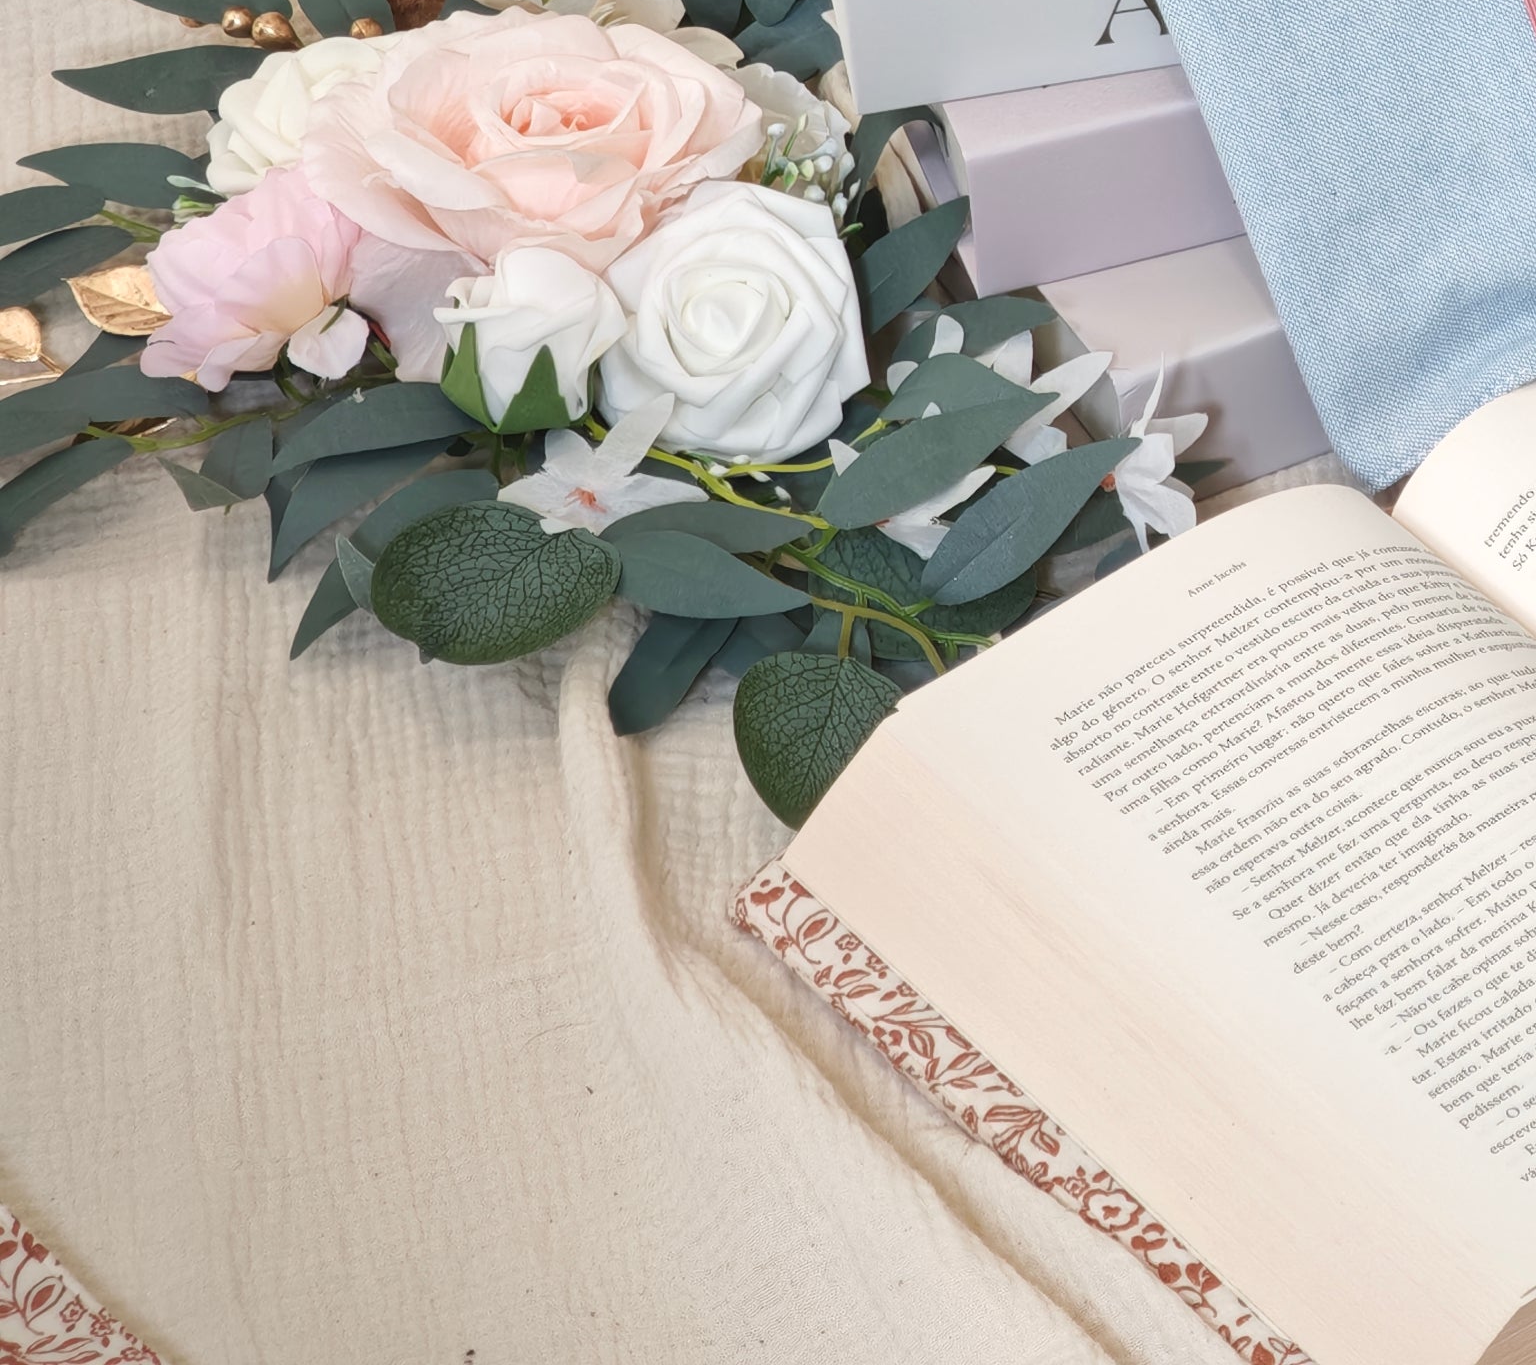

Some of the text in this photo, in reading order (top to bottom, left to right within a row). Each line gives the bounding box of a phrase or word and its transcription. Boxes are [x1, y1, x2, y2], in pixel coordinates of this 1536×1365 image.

[1187, 562, 1247, 598] Anne Jacobs
[1484, 490, 1535, 548] tremendo
[1498, 524, 1529, 559] tenha
[1512, 552, 1528, 572] Só
[1049, 731, 1079, 751] algo
[1081, 718, 1100, 732] do
[1151, 673, 1166, 686] O
[1168, 644, 1213, 678] senhor
[1213, 616, 1260, 648] Melzer
[1263, 573, 1354, 619] contemplou-a
[1353, 564, 1378, 579] por
[1379, 559, 1404, 569] um
[1054, 698, 1096, 726] Marie
[1097, 681, 1123, 700] não
[1124, 648, 1177, 685] pareceu
[1266, 584, 1277, 597] é
[1331, 555, 1356, 568] que
[1355, 549, 1371, 562] já
[1063, 603, 1324, 764] absorto no contraste entre o vestido escuro
[1123, 719, 1200, 770] semelhança
[1200, 662, 1292, 721] extraordinária
[1292, 640, 1327, 663] entre
[1327, 631, 1344, 643] as
[1380, 604, 1410, 621] pelo
[1132, 713, 1175, 741] Marie
[1172, 667, 1245, 716] Hofgartner
[1246, 655, 1269, 670] era
[1268, 631, 1309, 660] pouco
[1309, 613, 1342, 633] mais
[1340, 598, 1378, 616] velha
[1377, 591, 1396, 602] do
